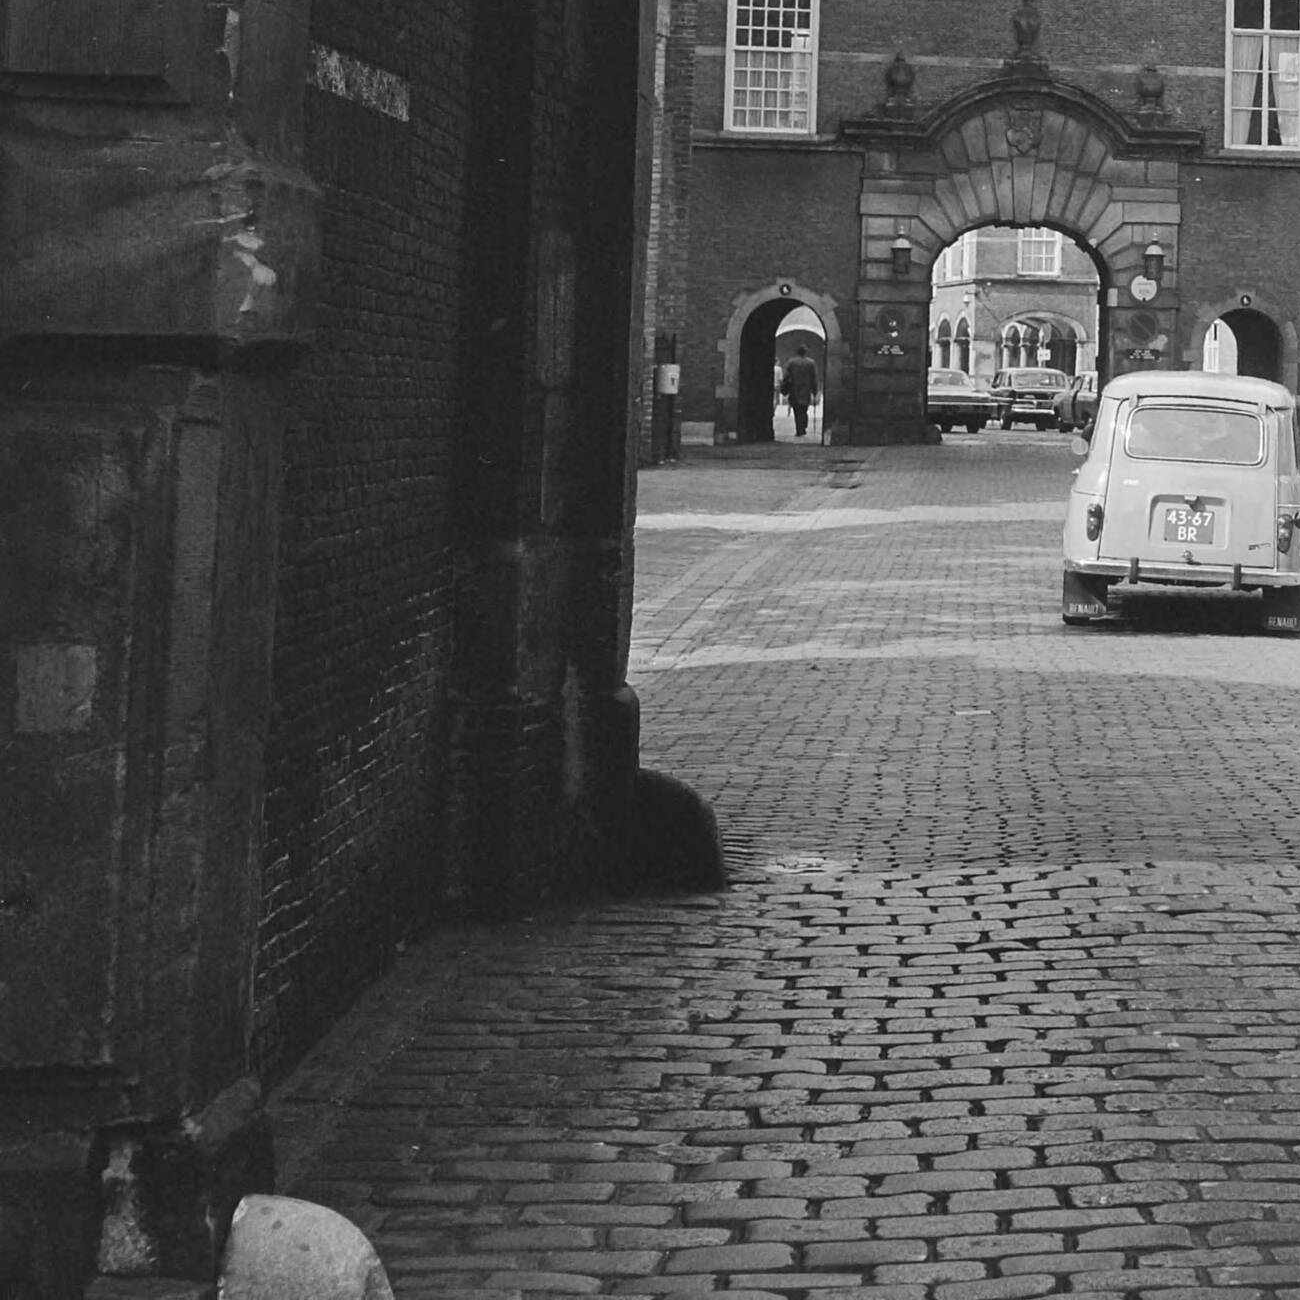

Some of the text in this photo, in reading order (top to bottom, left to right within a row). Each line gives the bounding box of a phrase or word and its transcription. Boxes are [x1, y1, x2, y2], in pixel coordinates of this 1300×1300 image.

[1177, 526, 1197, 541] BR
[1069, 603, 1098, 614] RENAULT
[1267, 615, 1297, 628] RENAULT
